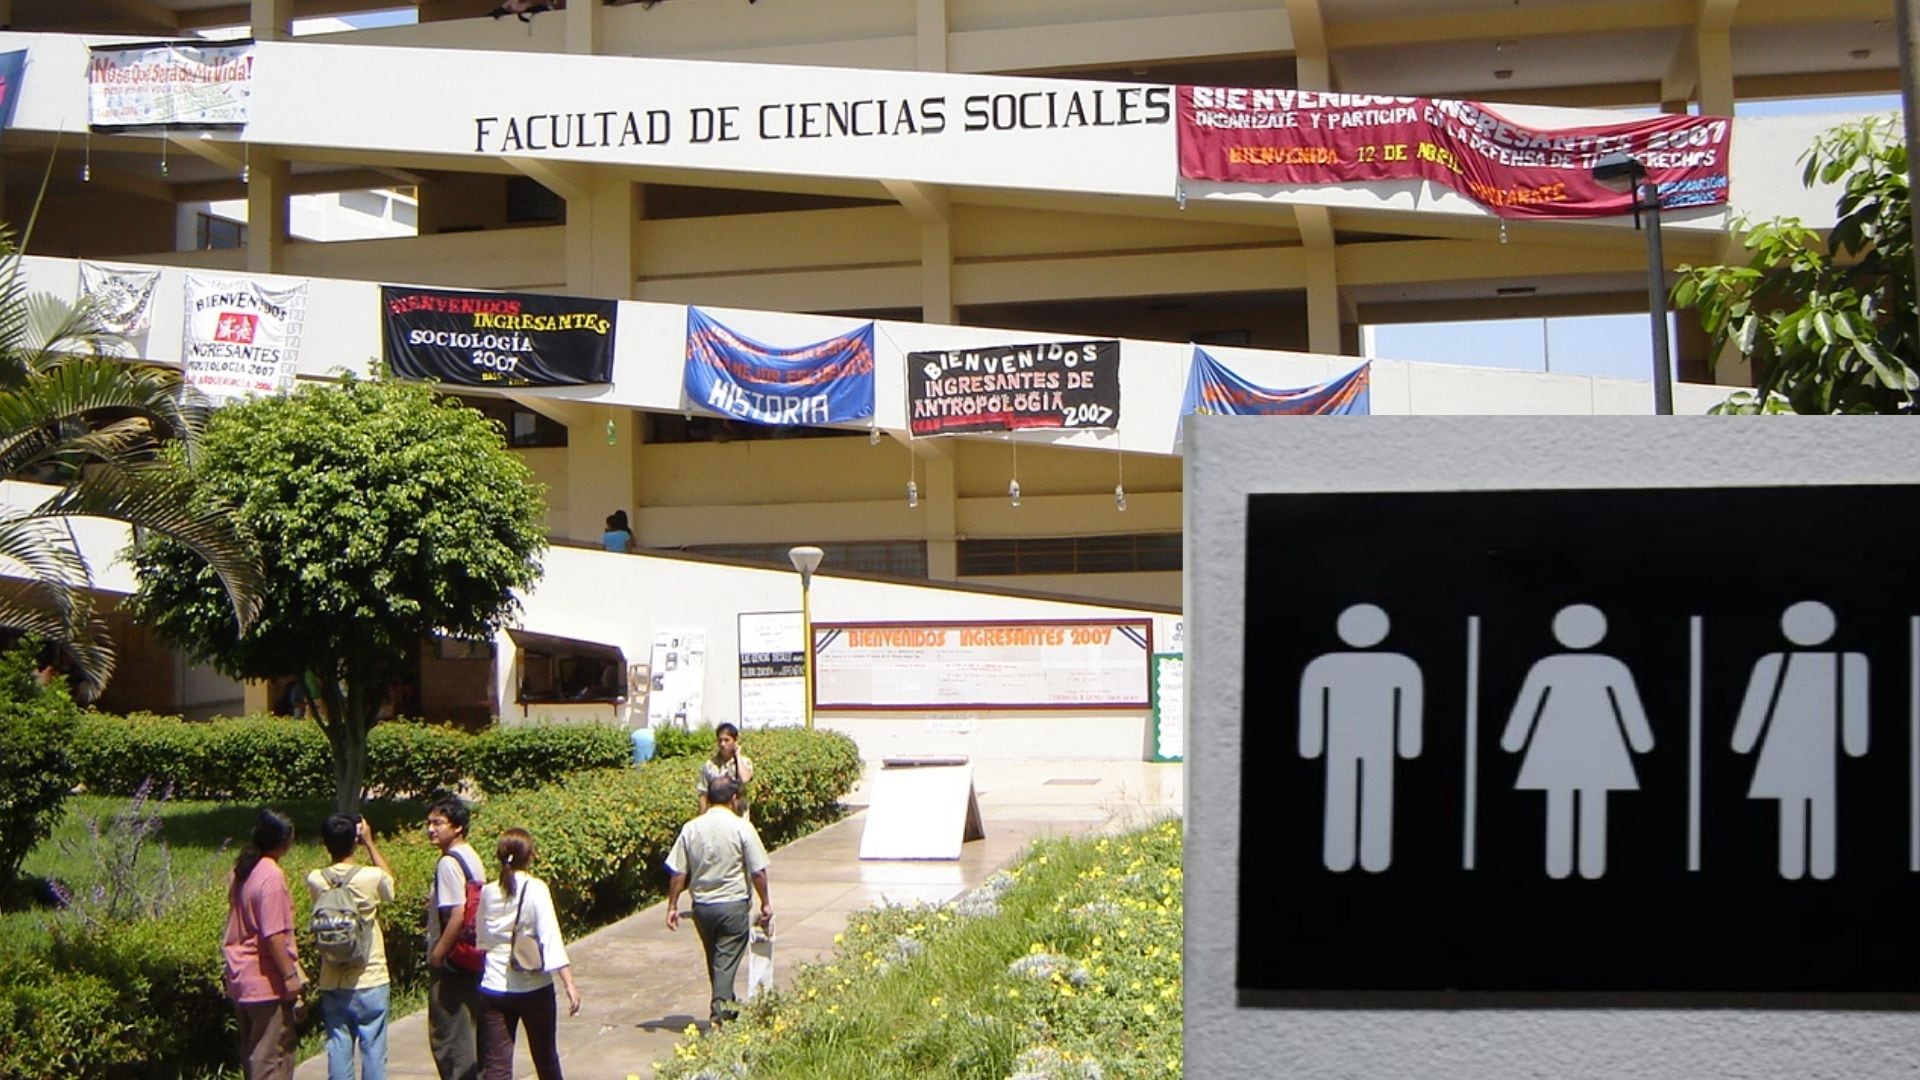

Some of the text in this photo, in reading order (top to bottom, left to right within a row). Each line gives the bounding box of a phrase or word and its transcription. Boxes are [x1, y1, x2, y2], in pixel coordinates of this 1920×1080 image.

[475, 87, 1170, 152] FACULTAD DE CIENCIAS SOCIALES
[1311, 112, 1321, 129] Y
[1328, 106, 1418, 130] PARTICIPA
[1447, 120, 1468, 143] LA
[1469, 132, 1546, 168] DEFENSA
[1550, 149, 1575, 169] DE
[1358, 145, 1376, 162] 12
[1384, 144, 1408, 161] DE
[389, 295, 521, 316] BIENVENIDOS
[473, 312, 610, 335] INGRESANTES
[409, 328, 533, 352] SOCIOLOGÍA
[472, 350, 518, 373] 2007
[924, 344, 1098, 380] BIENVENIDOS
[925, 371, 1094, 397] INGRESANTES DE
[707, 378, 830, 425] HISTORIA
[914, 391, 1064, 418] ANTROPOLOGIA
[1063, 403, 1113, 426] 2007
[848, 627, 1113, 648] BIENVENIDOS INGRESANTES 2007
